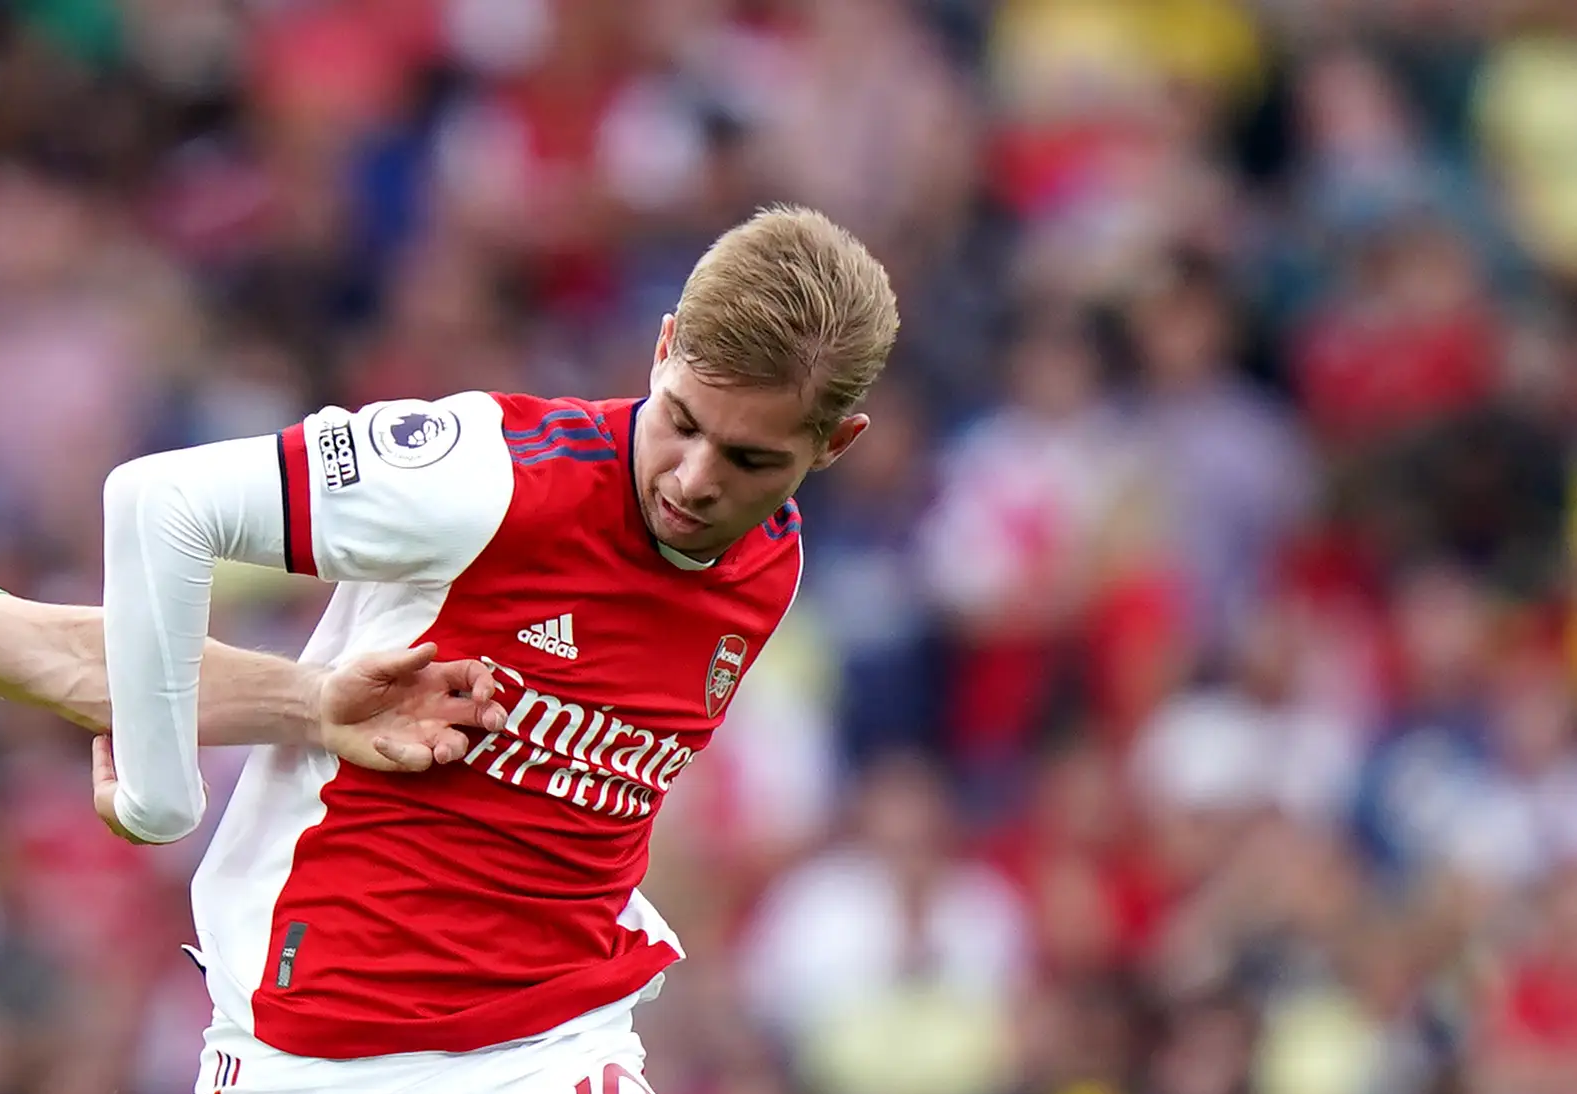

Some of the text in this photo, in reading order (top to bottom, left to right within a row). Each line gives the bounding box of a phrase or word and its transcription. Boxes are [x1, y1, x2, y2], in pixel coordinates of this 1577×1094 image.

[333, 426, 356, 481] room
[517, 627, 578, 660] adidas
[480, 655, 696, 792] mirate
[464, 732, 552, 785] FLY
